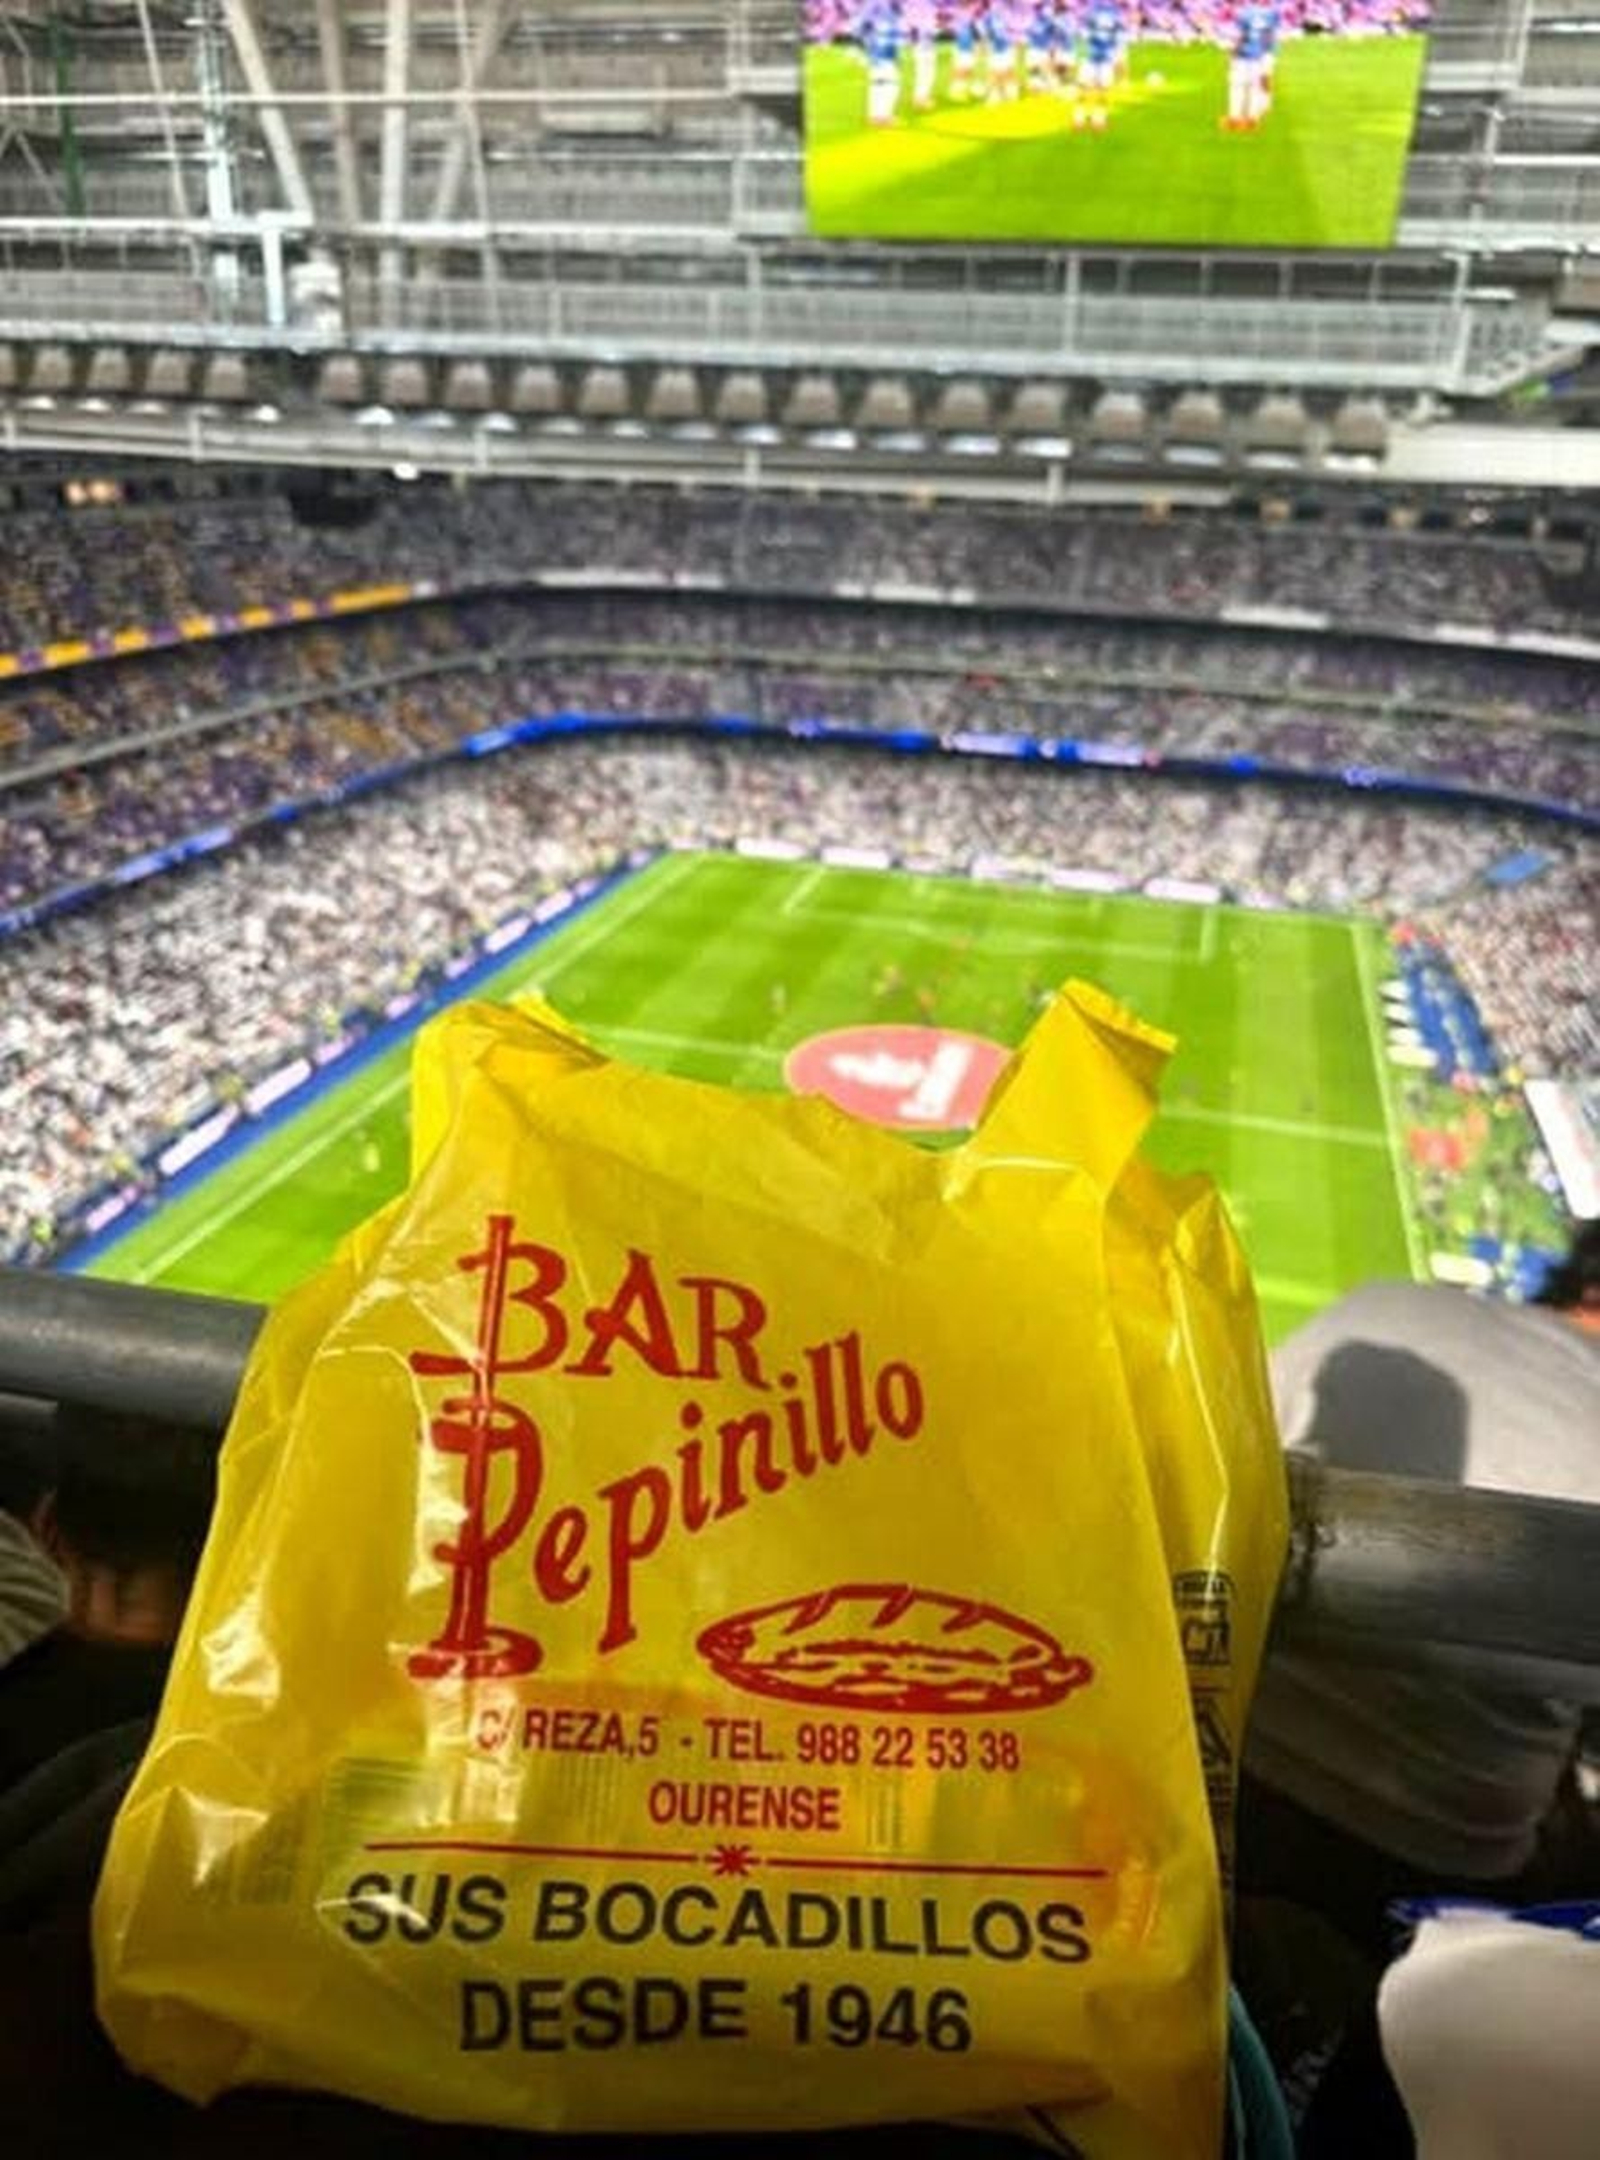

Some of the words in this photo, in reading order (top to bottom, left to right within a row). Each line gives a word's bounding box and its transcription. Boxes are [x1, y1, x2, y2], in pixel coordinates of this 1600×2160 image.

[410, 1215, 770, 1390] BAR
[406, 1333, 924, 1679] Pepinillo
[704, 1718, 786, 1763] TEL.
[797, 1722, 860, 1766] 988
[871, 1726, 915, 1768] 22
[926, 1727, 968, 1770] 53
[977, 1730, 1020, 1772] 38
[648, 1781, 841, 1831] OURENSE
[344, 1873, 507, 1944] SUS
[533, 1881, 1092, 1963] BOCADILLOS
[459, 1977, 747, 2053] DESDE
[780, 1982, 972, 2052] 1946
